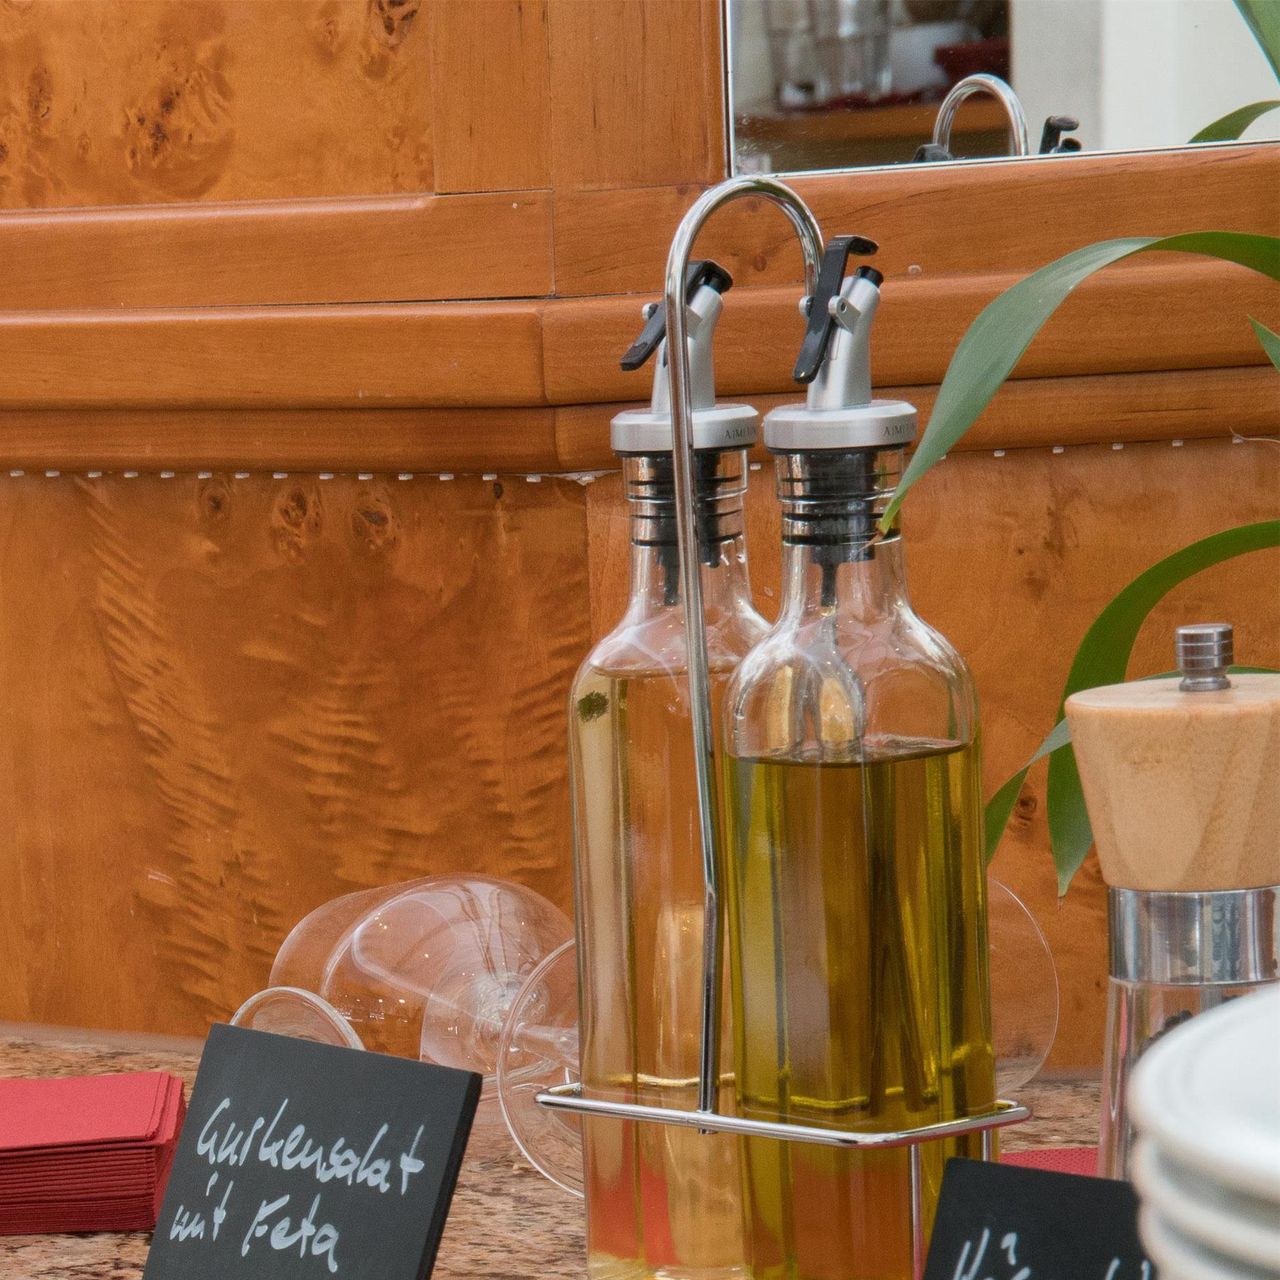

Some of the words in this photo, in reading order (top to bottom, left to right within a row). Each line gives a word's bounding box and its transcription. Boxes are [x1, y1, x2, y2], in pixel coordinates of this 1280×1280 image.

[196, 1096, 425, 1196] Gurkensalat
[169, 1171, 234, 1243] mit
[241, 1193, 340, 1274] Feta
